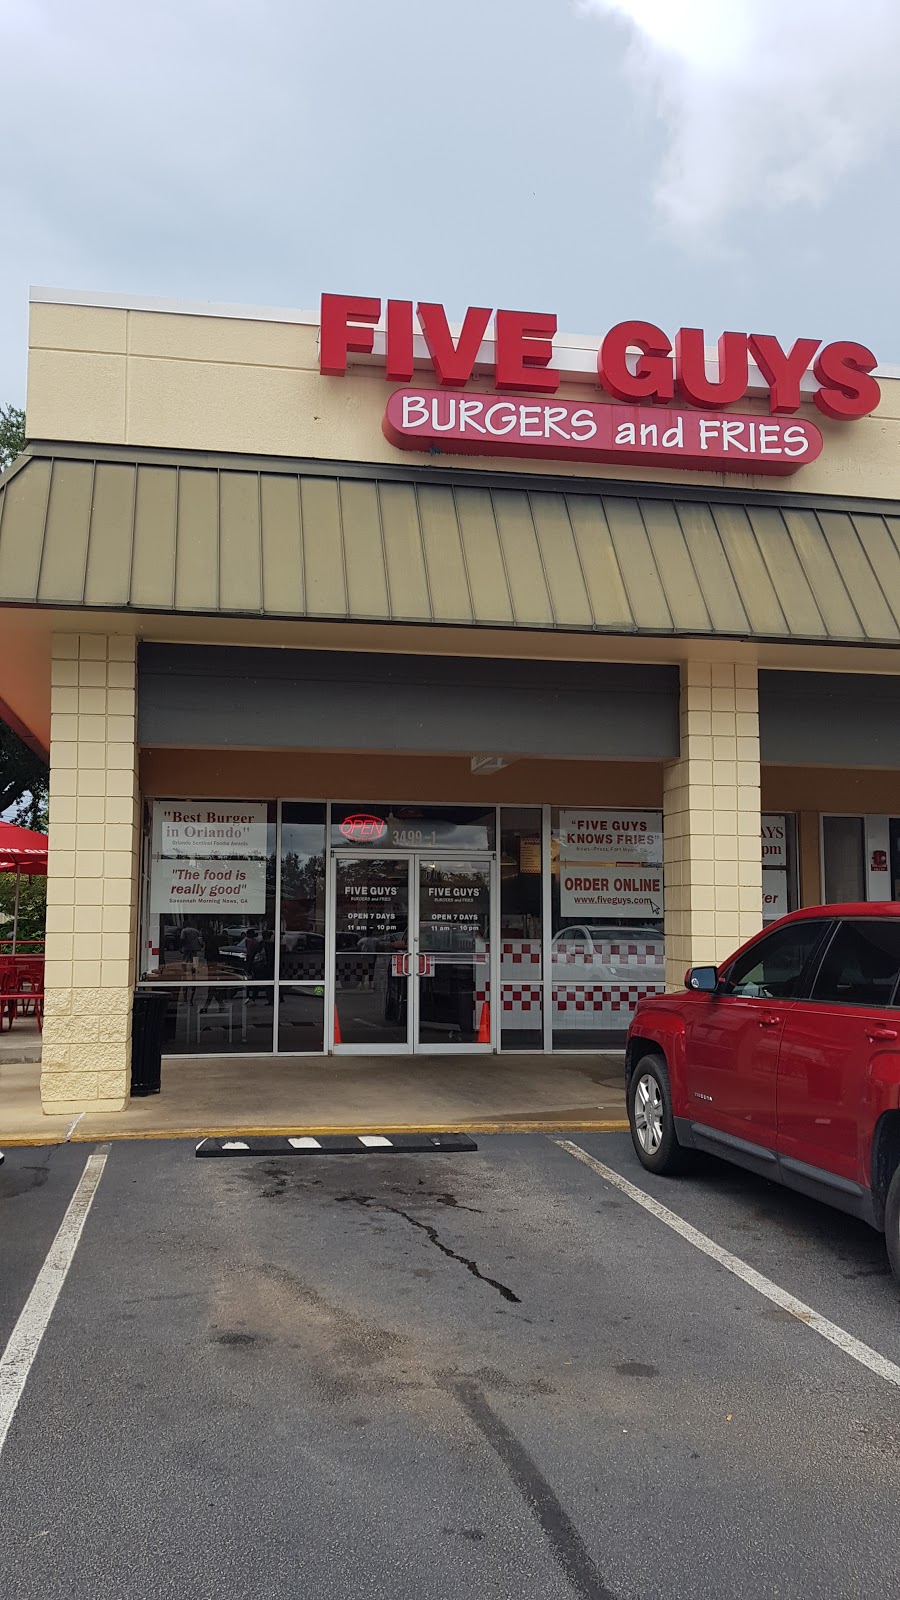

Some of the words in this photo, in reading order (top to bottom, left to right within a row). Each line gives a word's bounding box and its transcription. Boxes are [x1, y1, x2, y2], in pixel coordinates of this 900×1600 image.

[320, 292, 560, 393] FIVE
[597, 320, 881, 421] GUYS
[402, 396, 598, 442] BURGERS
[615, 417, 684, 449] and
[700, 420, 809, 457] FRIES
[164, 811, 202, 823] "Best
[206, 812, 255, 826] Burger
[340, 819, 385, 835] OPEN
[571, 820, 608, 831] "FIVE
[612, 821, 647, 831] GUYS
[166, 826, 179, 837] in
[184, 826, 250, 838] Orlando"
[760, 826, 784, 839] AYS
[567, 833, 613, 844] KNOWS
[616, 835, 660, 845] FRIES"
[172, 869, 200, 880] "The
[203, 869, 233, 880] food
[236, 870, 247, 881] is
[170, 884, 207, 896] really
[209, 884, 247, 896] good"
[344, 886, 368, 895] FIVE
[370, 886, 398, 895] GUYS
[564, 877, 609, 891] ORDER
[613, 878, 661, 892] ONLINE
[428, 887, 451, 896] FIVE
[453, 887, 480, 897] GUYS
[574, 895, 652, 905] www.fiveguys.com
